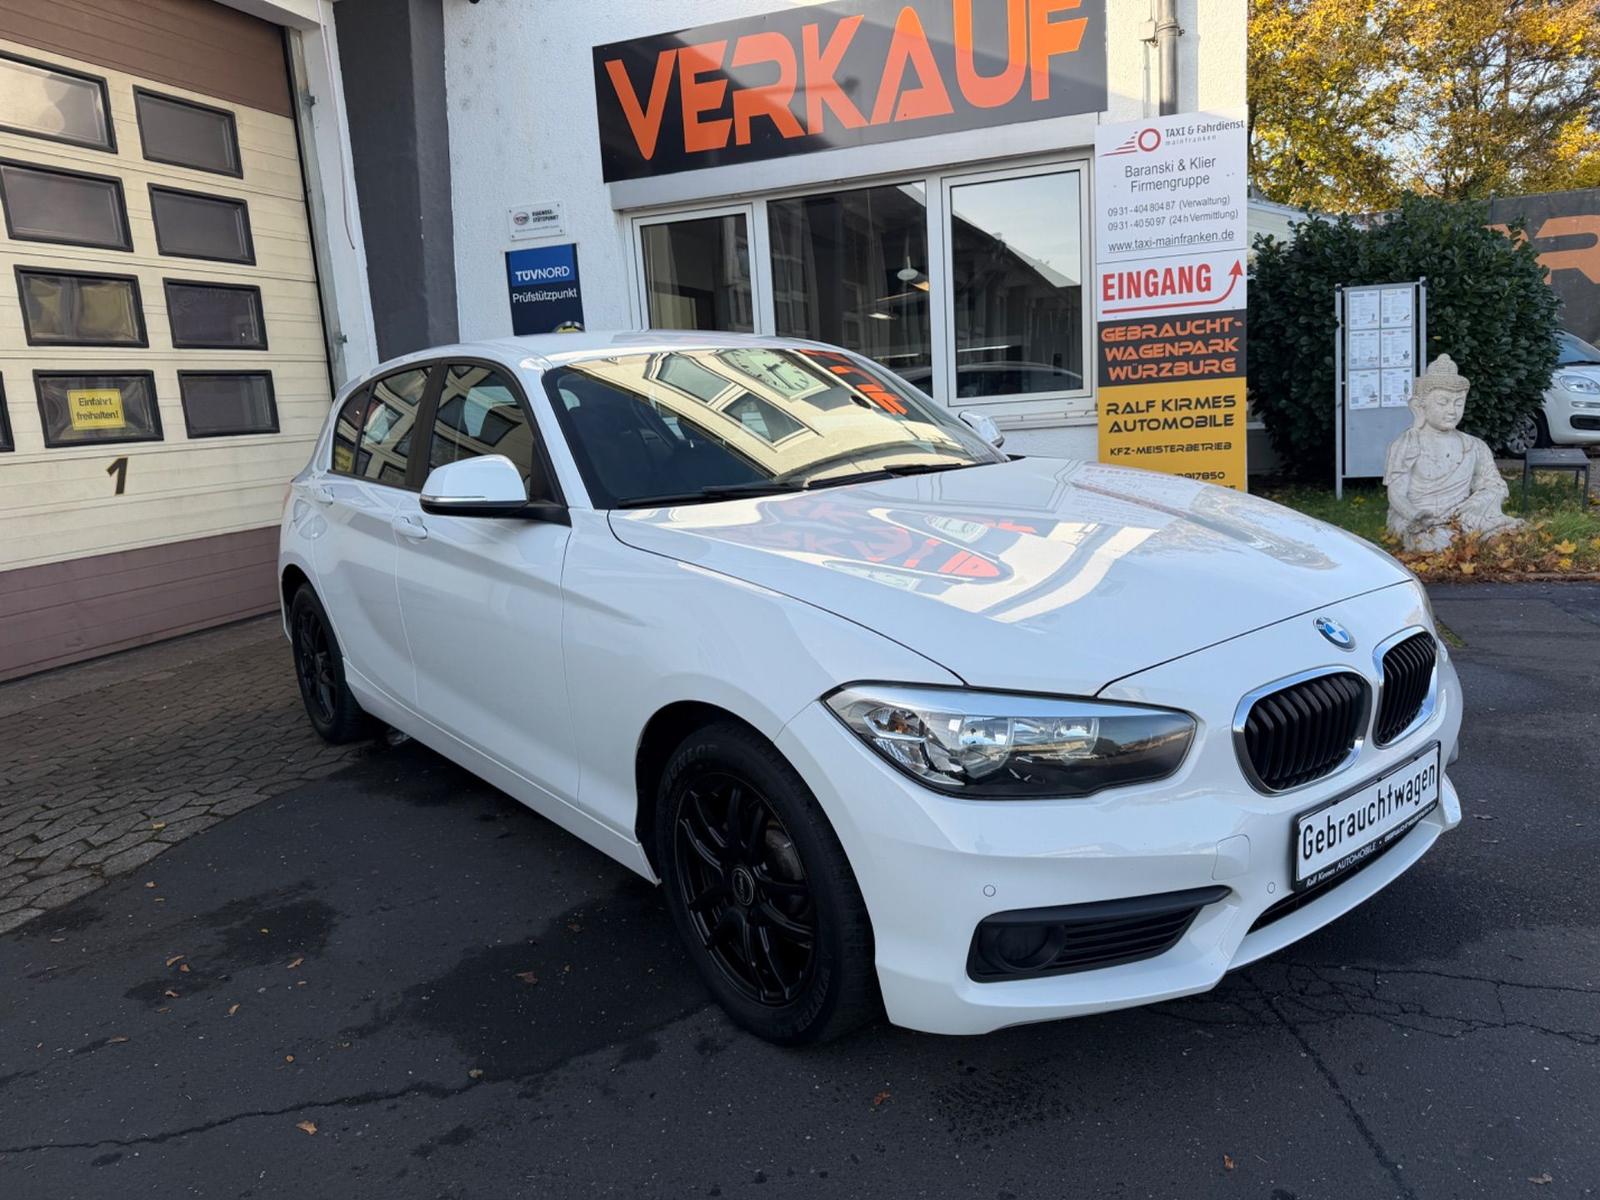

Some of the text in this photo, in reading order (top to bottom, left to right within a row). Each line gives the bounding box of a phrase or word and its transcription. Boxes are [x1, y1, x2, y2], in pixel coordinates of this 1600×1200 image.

[604, 0, 1088, 160] VERKAUF
[1165, 119, 1245, 138] TAXI & Fahrdienst
[1125, 156, 1217, 178] Baranski & Klier
[1131, 173, 1210, 193] Firmengruppe
[1179, 195, 1231, 210] (Verwaltung)
[1108, 229, 1234, 252] www.taxi-mainfranken.de
[1103, 263, 1211, 302] EINGANG
[512, 287, 577, 304] Prüfstützpunkt
[1101, 317, 1243, 342] GEBRAUCHT-
[1104, 337, 1239, 361] WAGENPARK
[1108, 357, 1237, 381] WÜRZBURG
[78, 397, 113, 407] Einfahrt
[1106, 395, 1237, 416] RALF KIRMES
[76, 410, 119, 421] freihalten!
[1109, 413, 1235, 434] AUTOMOBILE
[1110, 441, 1232, 456] KFZ-MEISTERBETRIEB
[106, 457, 128, 495] 1
[1303, 764, 1435, 860] Gebrauchtwagen
[1336, 842, 1377, 871] AUTOMOBILE
